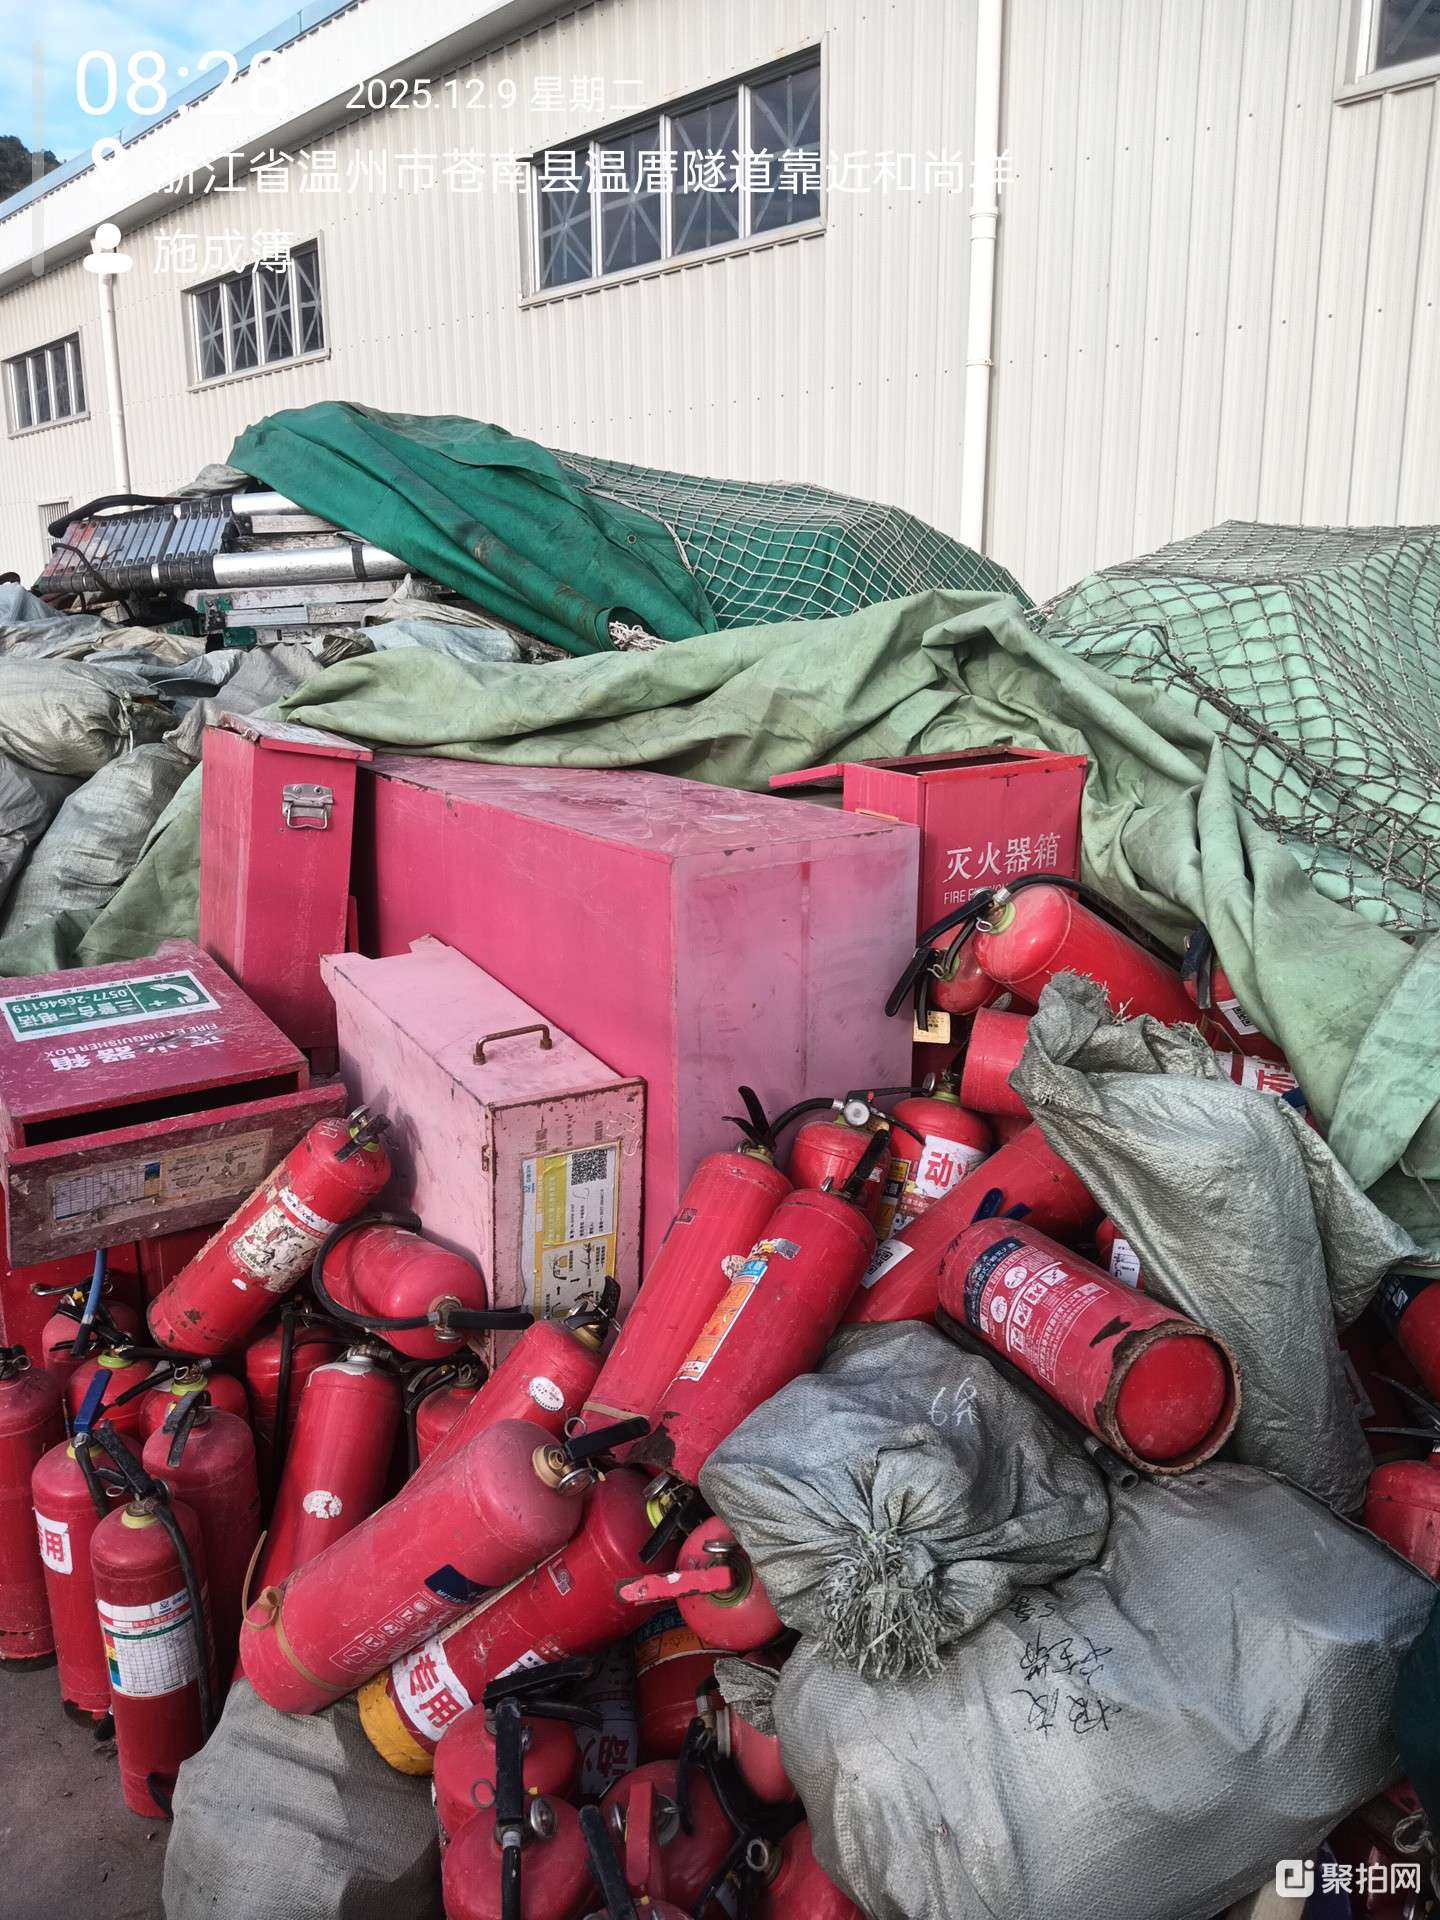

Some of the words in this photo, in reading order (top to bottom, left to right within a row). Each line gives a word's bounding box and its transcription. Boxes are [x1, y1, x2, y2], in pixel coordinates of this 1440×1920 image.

[942, 832, 1061, 884] 灭火器箱
[943, 887, 967, 904] FIRE
[12, 988, 128, 1014] 0577-26646119
[18, 999, 137, 1028] 三警合一电话
[186, 1022, 219, 1036] FIRE
[45, 1046, 78, 1058] BOX
[924, 1151, 964, 1189] 动
[40, 1528, 66, 1563] 用
[403, 1648, 465, 1729] 专用
